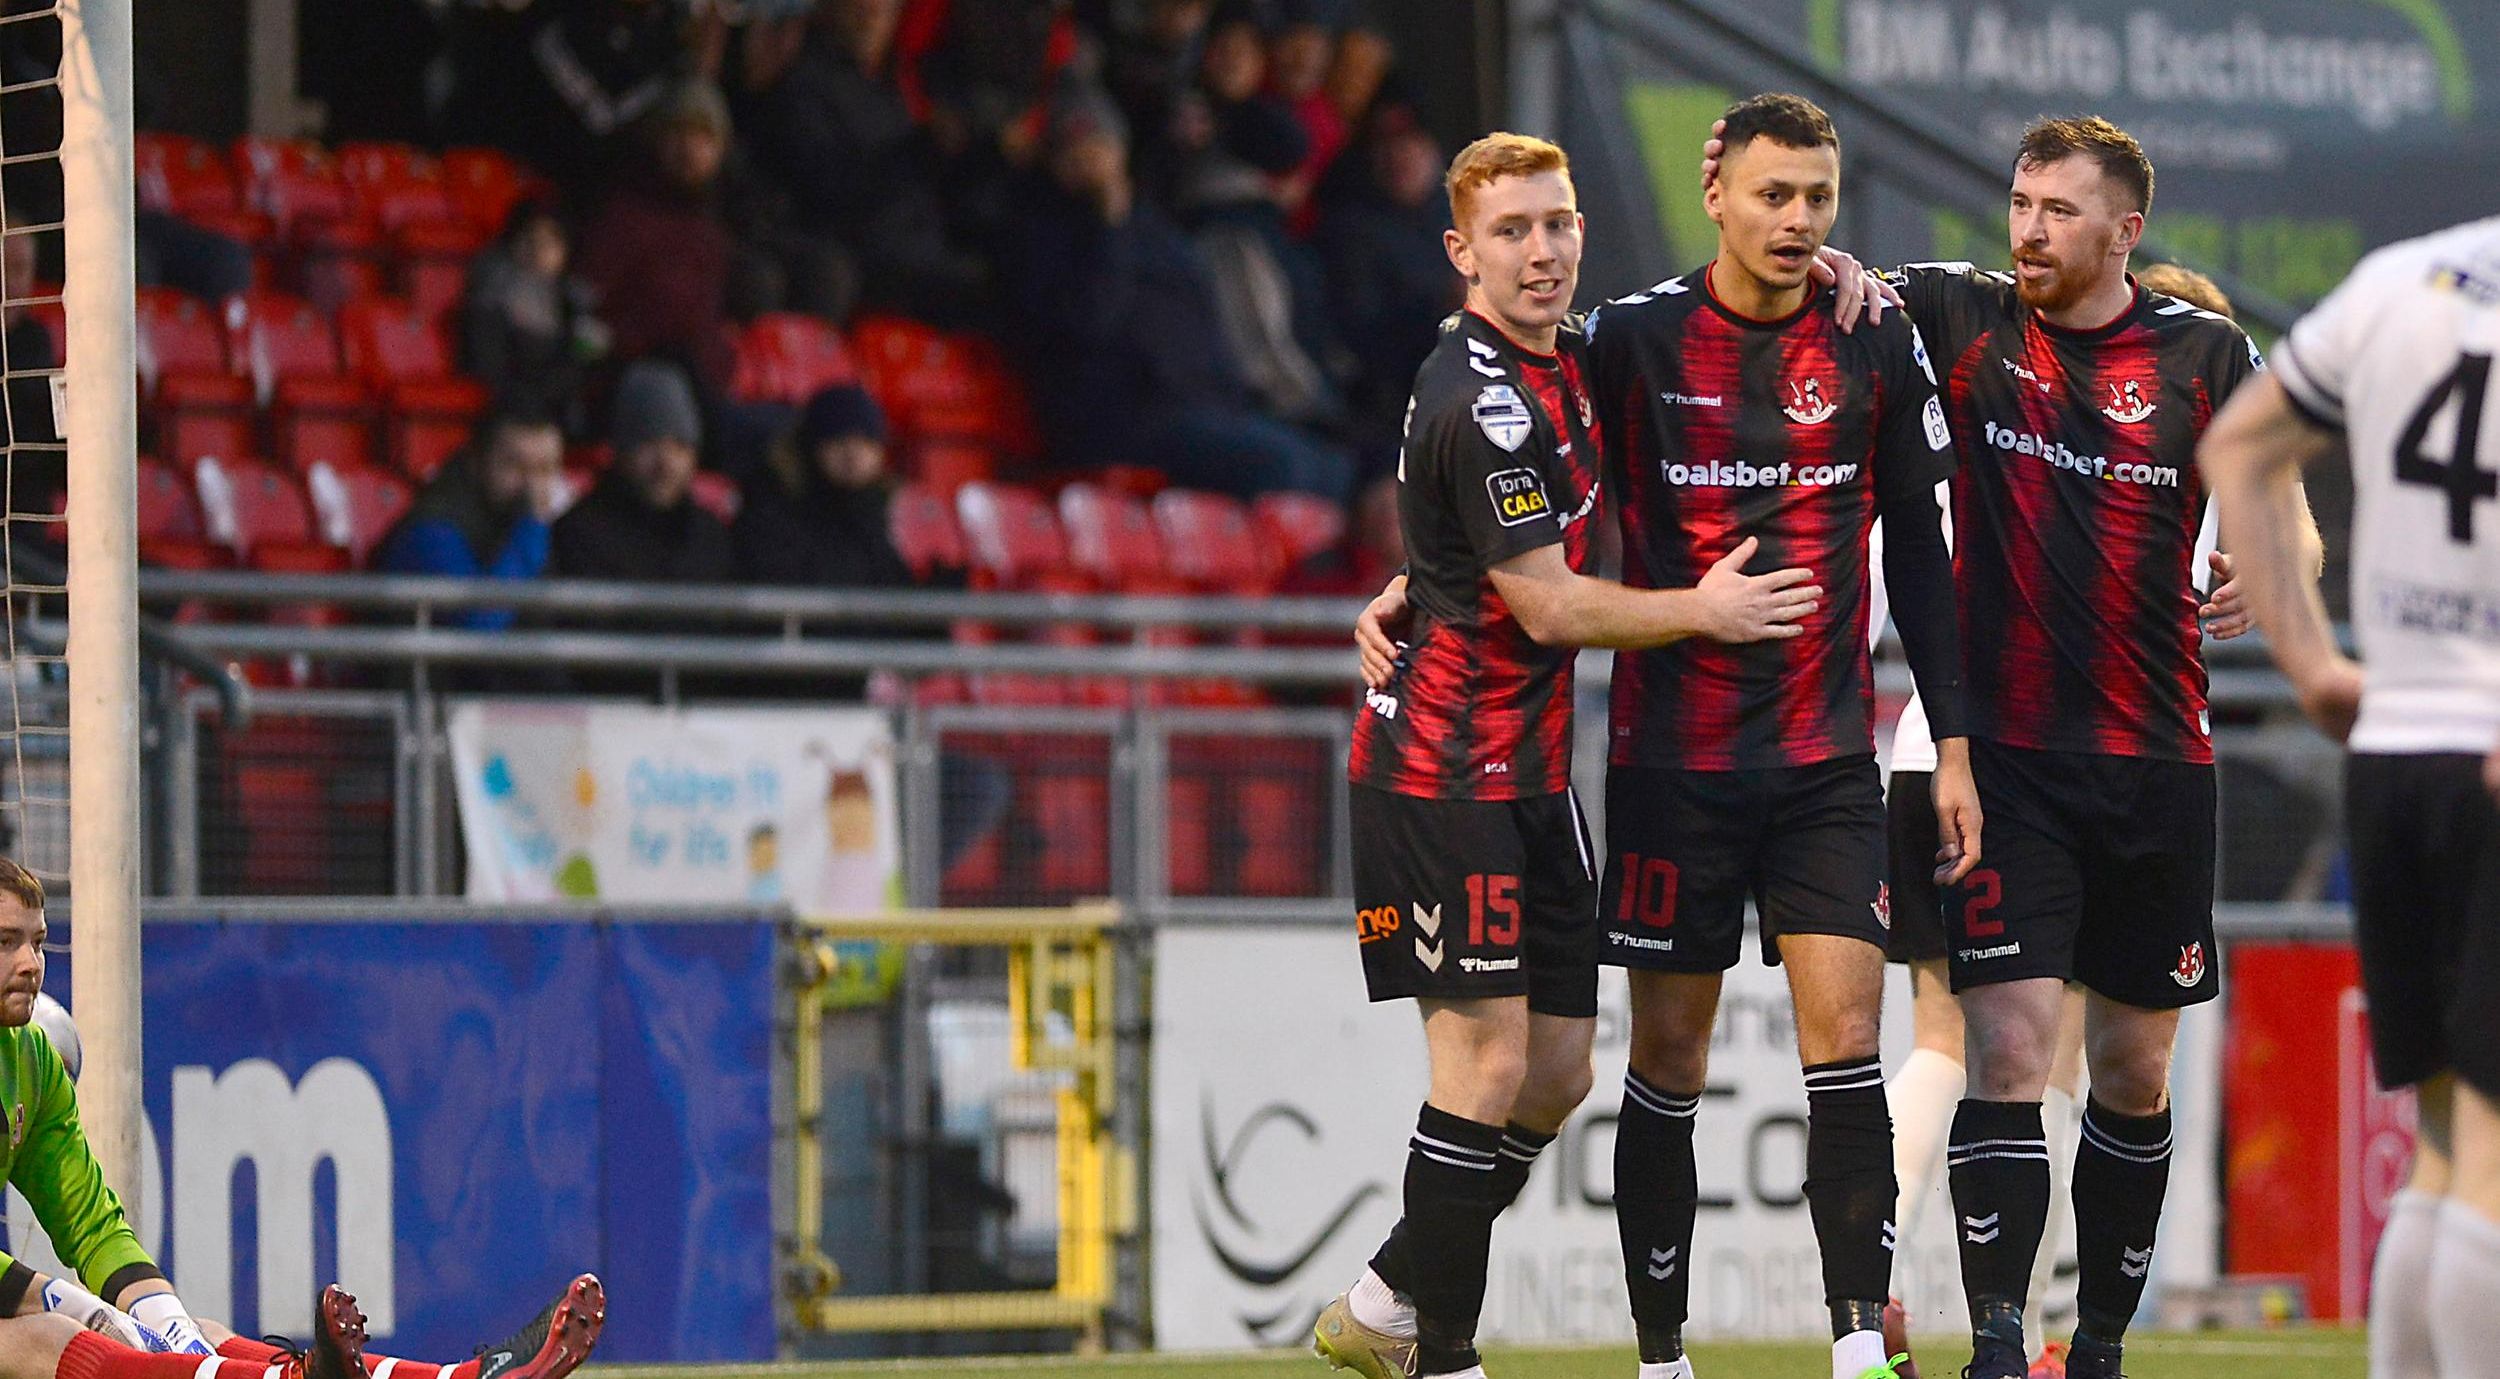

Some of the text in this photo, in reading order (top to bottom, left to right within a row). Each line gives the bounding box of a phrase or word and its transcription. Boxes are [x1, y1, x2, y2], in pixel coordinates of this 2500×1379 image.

[1966, 12, 2121, 94] Auto
[2126, 12, 2438, 128] Exchange
[1676, 394, 1722, 407] hummel
[1985, 421, 2179, 488] toalsbet.com
[2395, 350, 2497, 543] 4
[1661, 459, 1858, 487] toalsbet.com
[1502, 492, 1545, 516] CAB
[1465, 874, 1520, 945] 15
[1617, 852, 1680, 928] 10
[1964, 868, 2004, 938] 2
[1476, 956, 1519, 972] hummel
[1624, 934, 1673, 951] hummel
[1972, 941, 2021, 961] hummel
